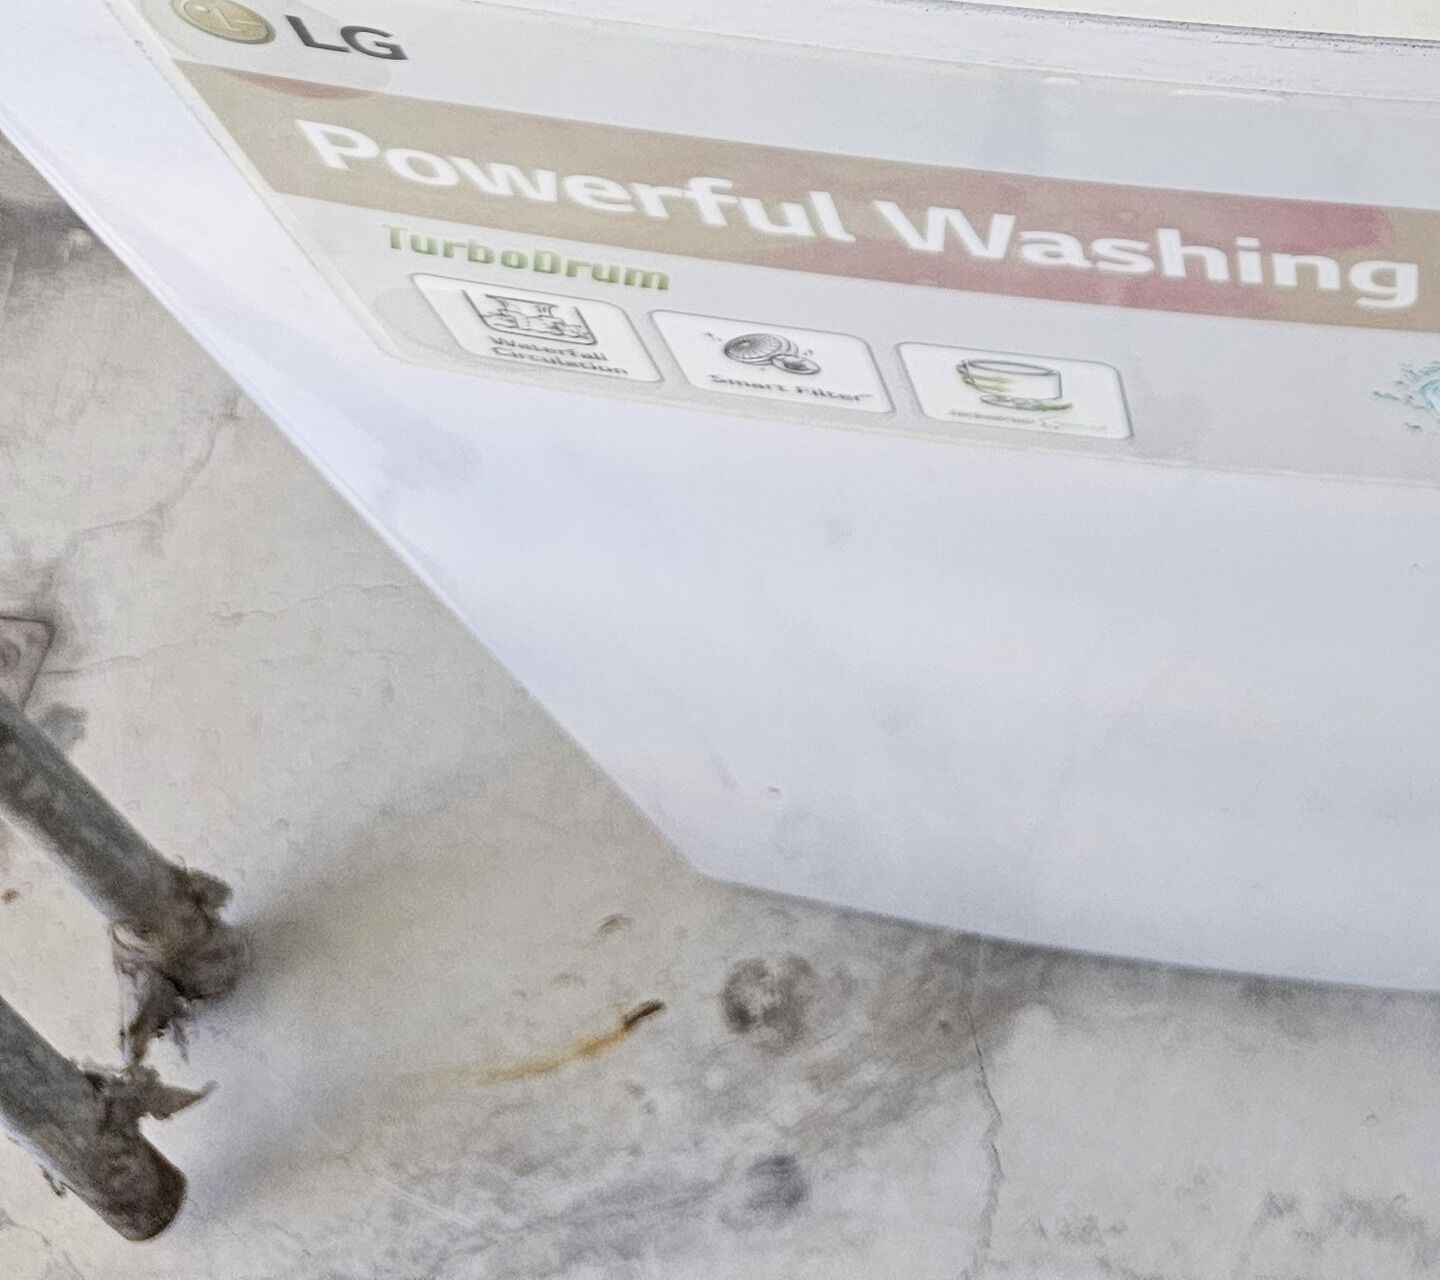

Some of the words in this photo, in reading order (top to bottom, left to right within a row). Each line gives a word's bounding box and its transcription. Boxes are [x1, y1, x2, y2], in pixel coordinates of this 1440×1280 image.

[283, 14, 409, 61] LG
[294, 118, 858, 245] Powerful
[871, 198, 1420, 310] Washing
[380, 224, 671, 292] TurboDrum
